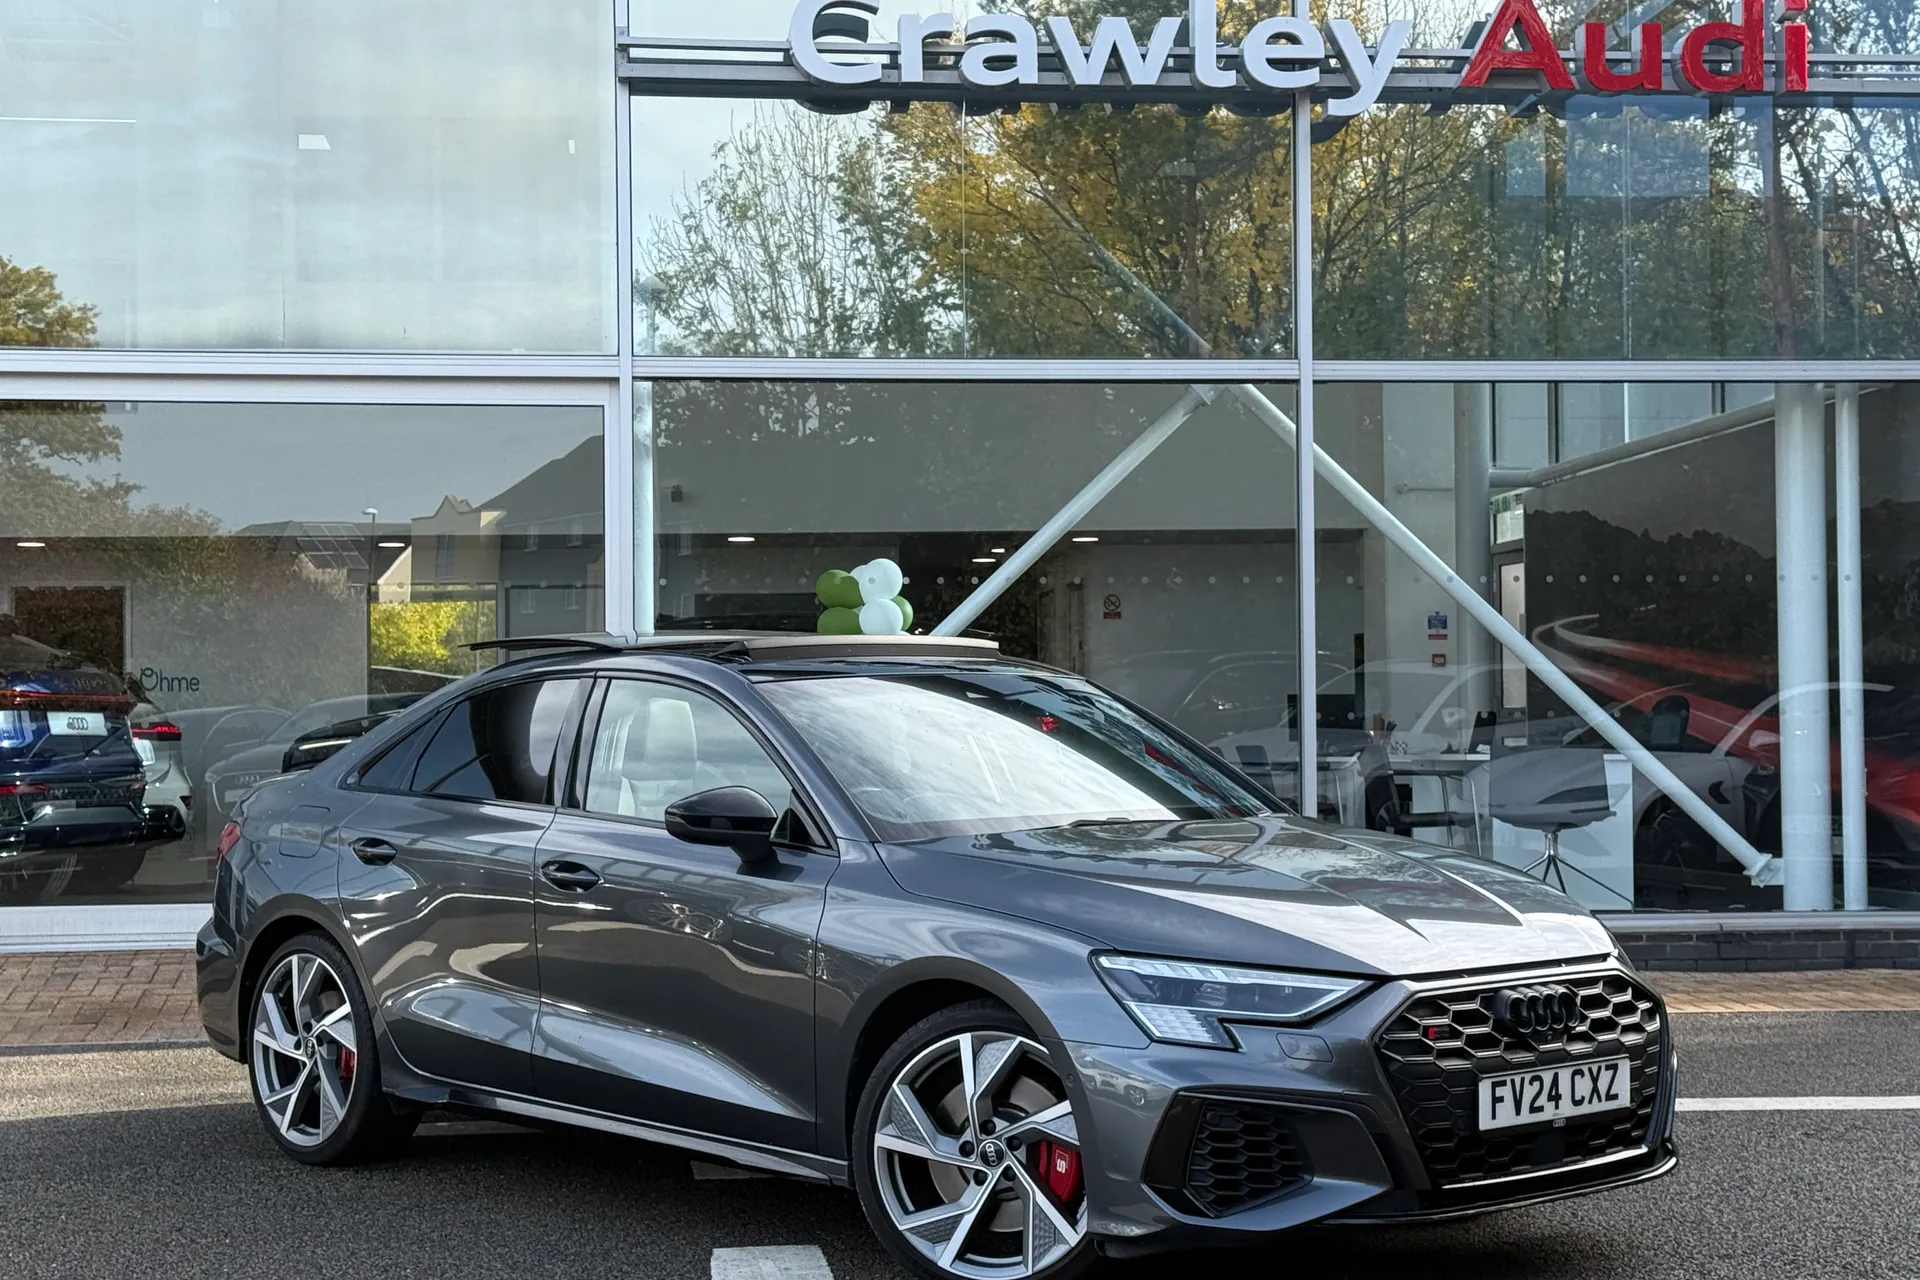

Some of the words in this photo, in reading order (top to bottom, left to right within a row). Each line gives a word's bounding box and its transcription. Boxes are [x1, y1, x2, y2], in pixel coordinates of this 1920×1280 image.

[789, 0, 1413, 117] Crawley
[1459, 0, 1809, 93] Audi
[140, 667, 200, 692] Ohme
[1490, 1071, 1563, 1121] FV24
[1570, 1062, 1620, 1108] CXZ
